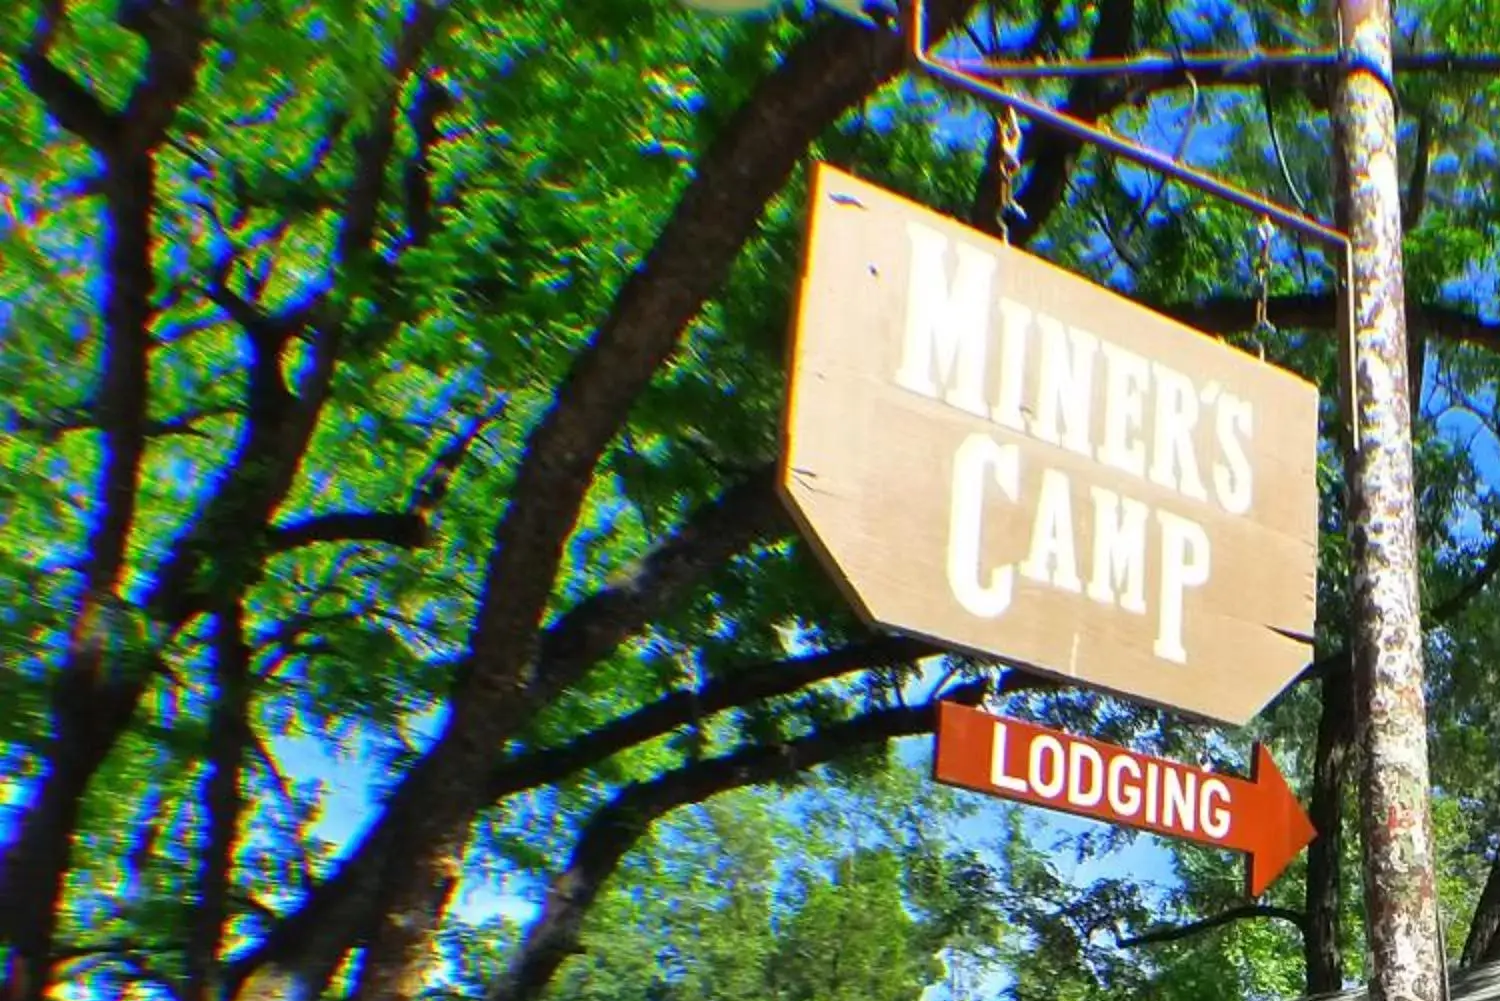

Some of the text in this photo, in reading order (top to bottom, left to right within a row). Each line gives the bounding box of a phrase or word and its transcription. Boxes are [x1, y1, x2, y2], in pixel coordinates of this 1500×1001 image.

[893, 223, 1254, 513] MINER'S
[947, 433, 1211, 663] CAMP
[990, 721, 1232, 839] LODGING
